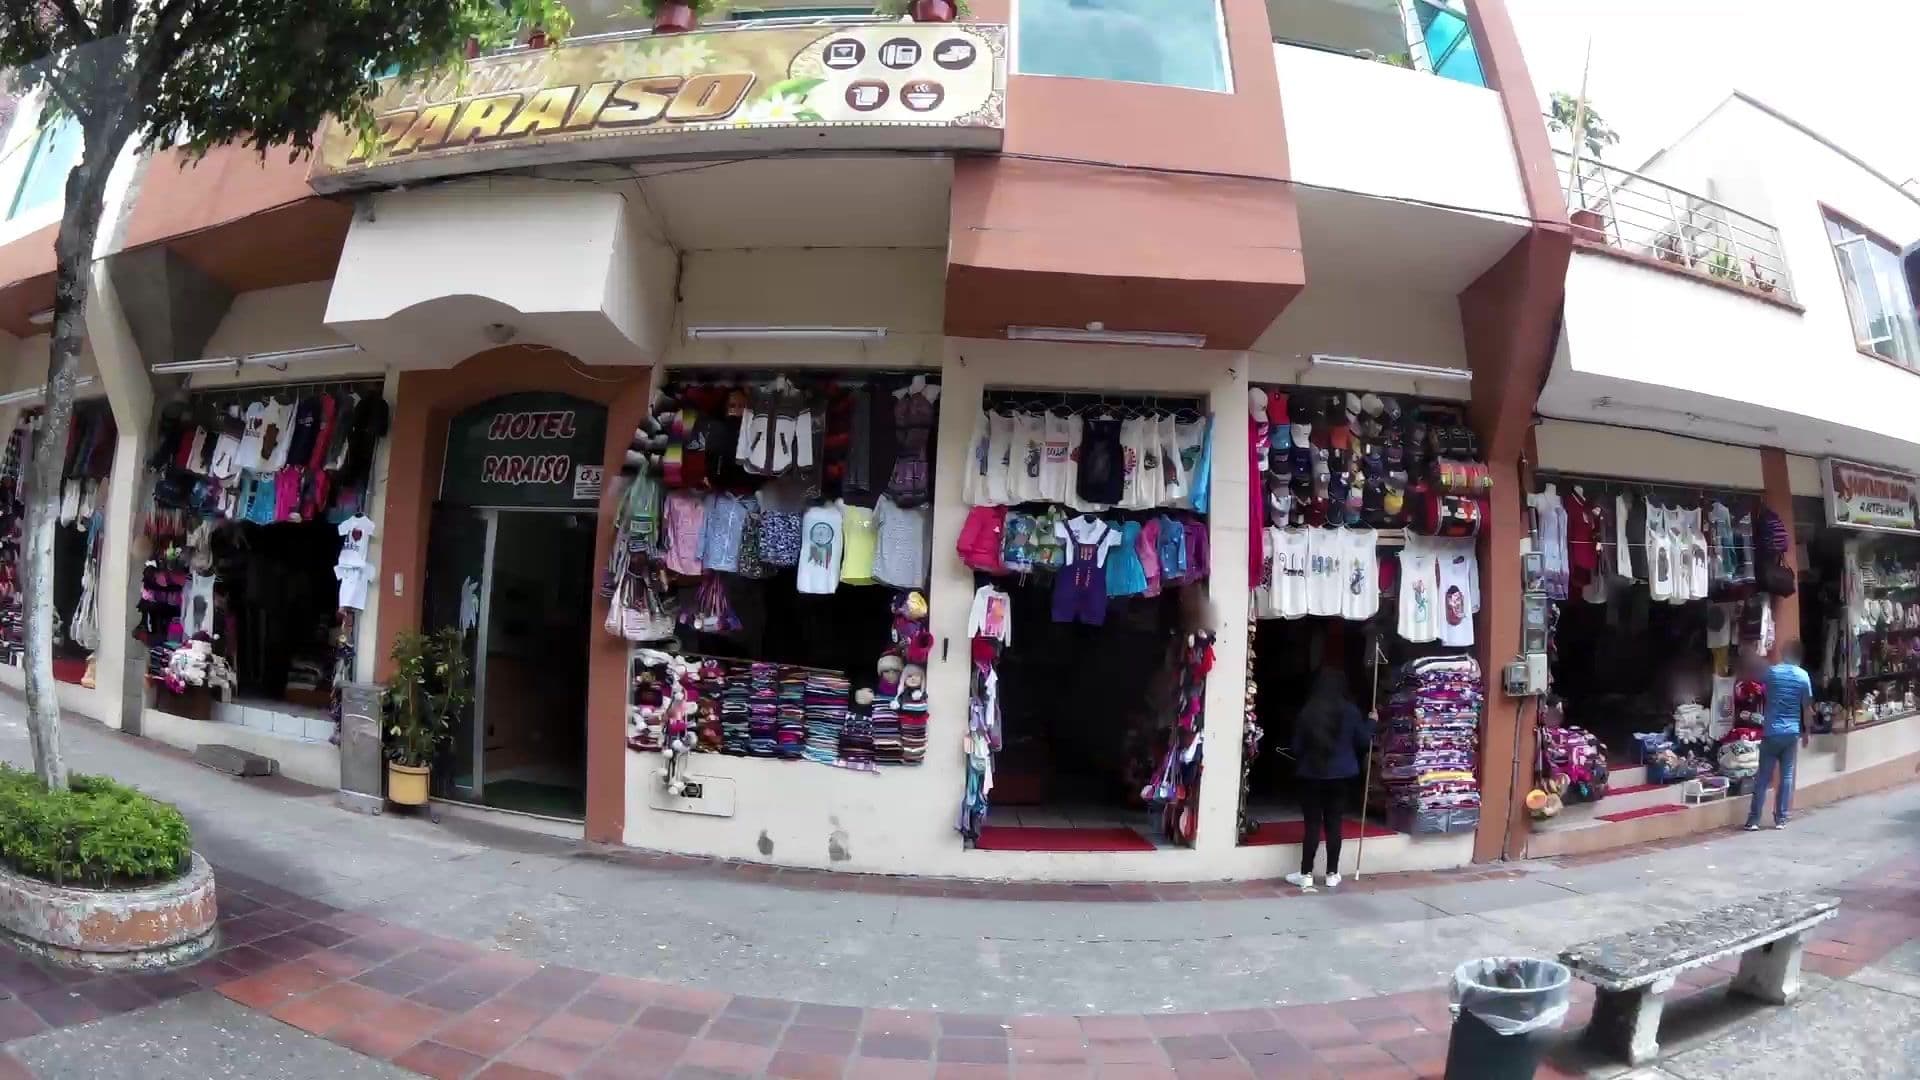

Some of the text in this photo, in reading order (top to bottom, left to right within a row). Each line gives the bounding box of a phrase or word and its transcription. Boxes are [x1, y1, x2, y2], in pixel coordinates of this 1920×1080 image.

[346, 71, 757, 164] PARAISO
[488, 410, 577, 440] HOTEL
[481, 454, 571, 486] PARAISO
